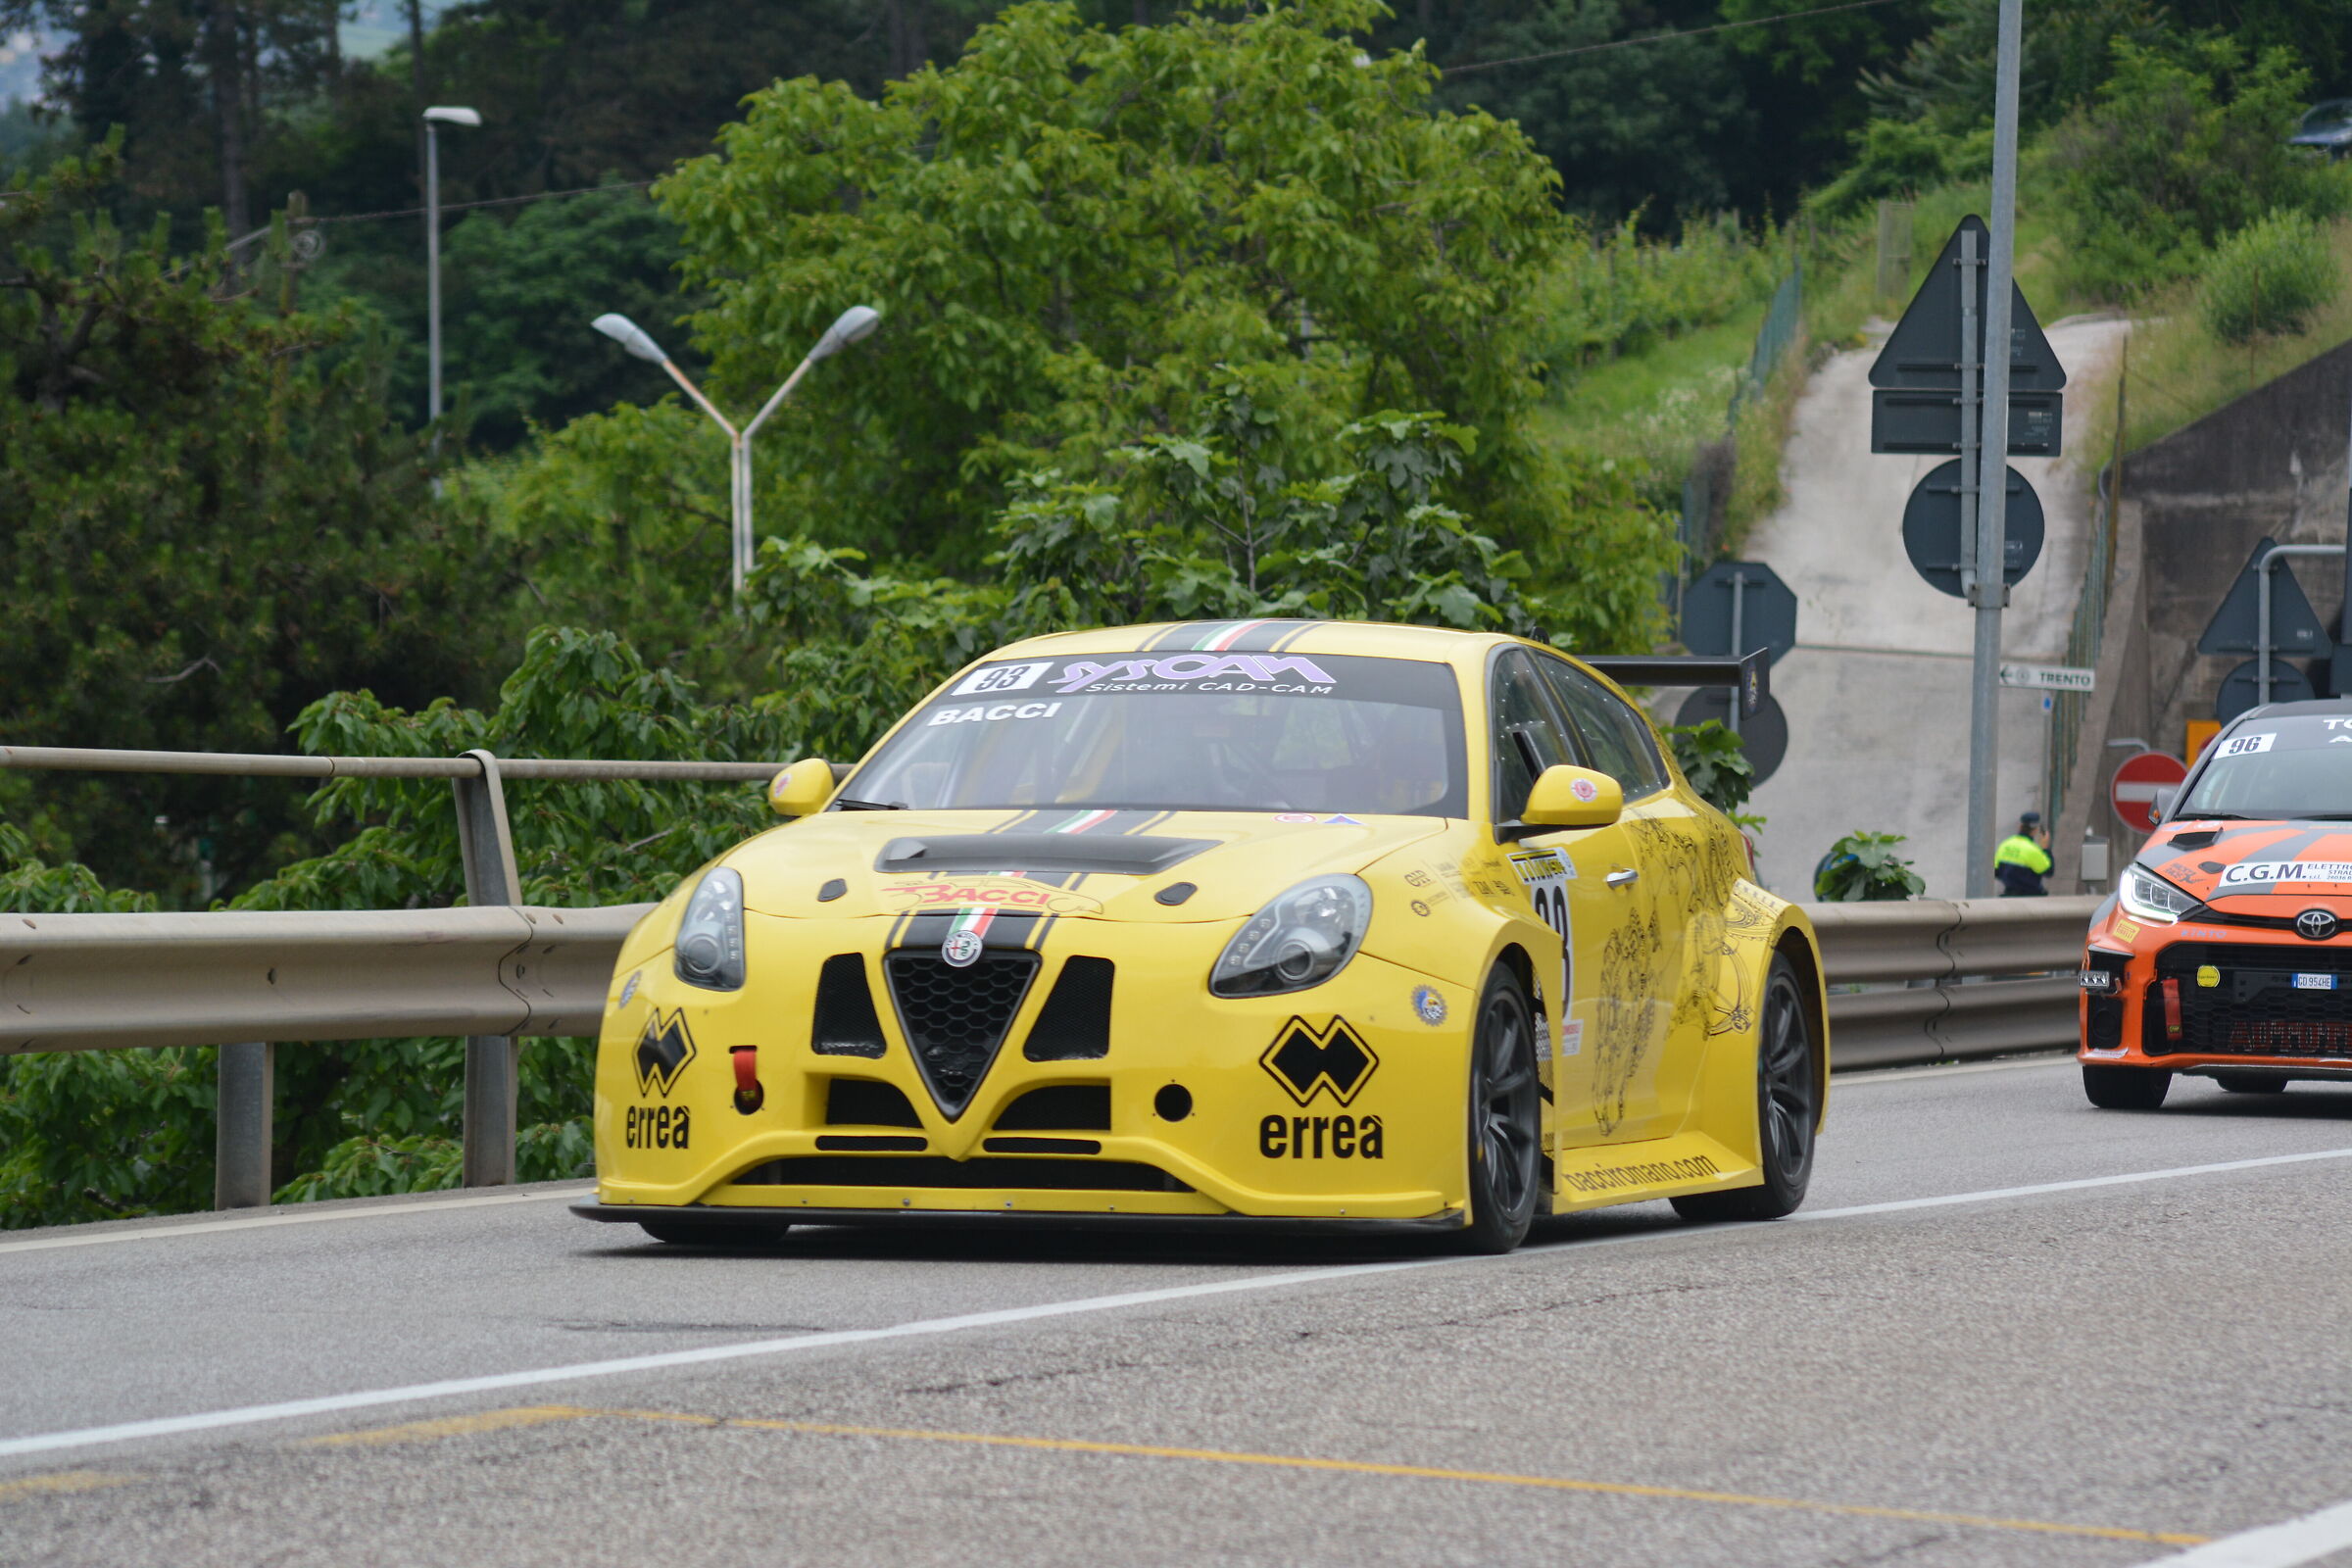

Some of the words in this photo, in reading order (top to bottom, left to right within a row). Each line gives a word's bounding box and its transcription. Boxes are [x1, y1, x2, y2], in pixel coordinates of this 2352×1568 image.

[974, 664, 1027, 691] 93
[2039, 671, 2090, 686] TRENTO
[1085, 682, 1189, 693] Sistemi
[1198, 682, 1333, 695] CAD-CAM
[926, 702, 1062, 726] BACCI
[2229, 736, 2262, 755] 96
[2226, 863, 2306, 883] C.G.M.
[881, 884, 1051, 905] BACCI
